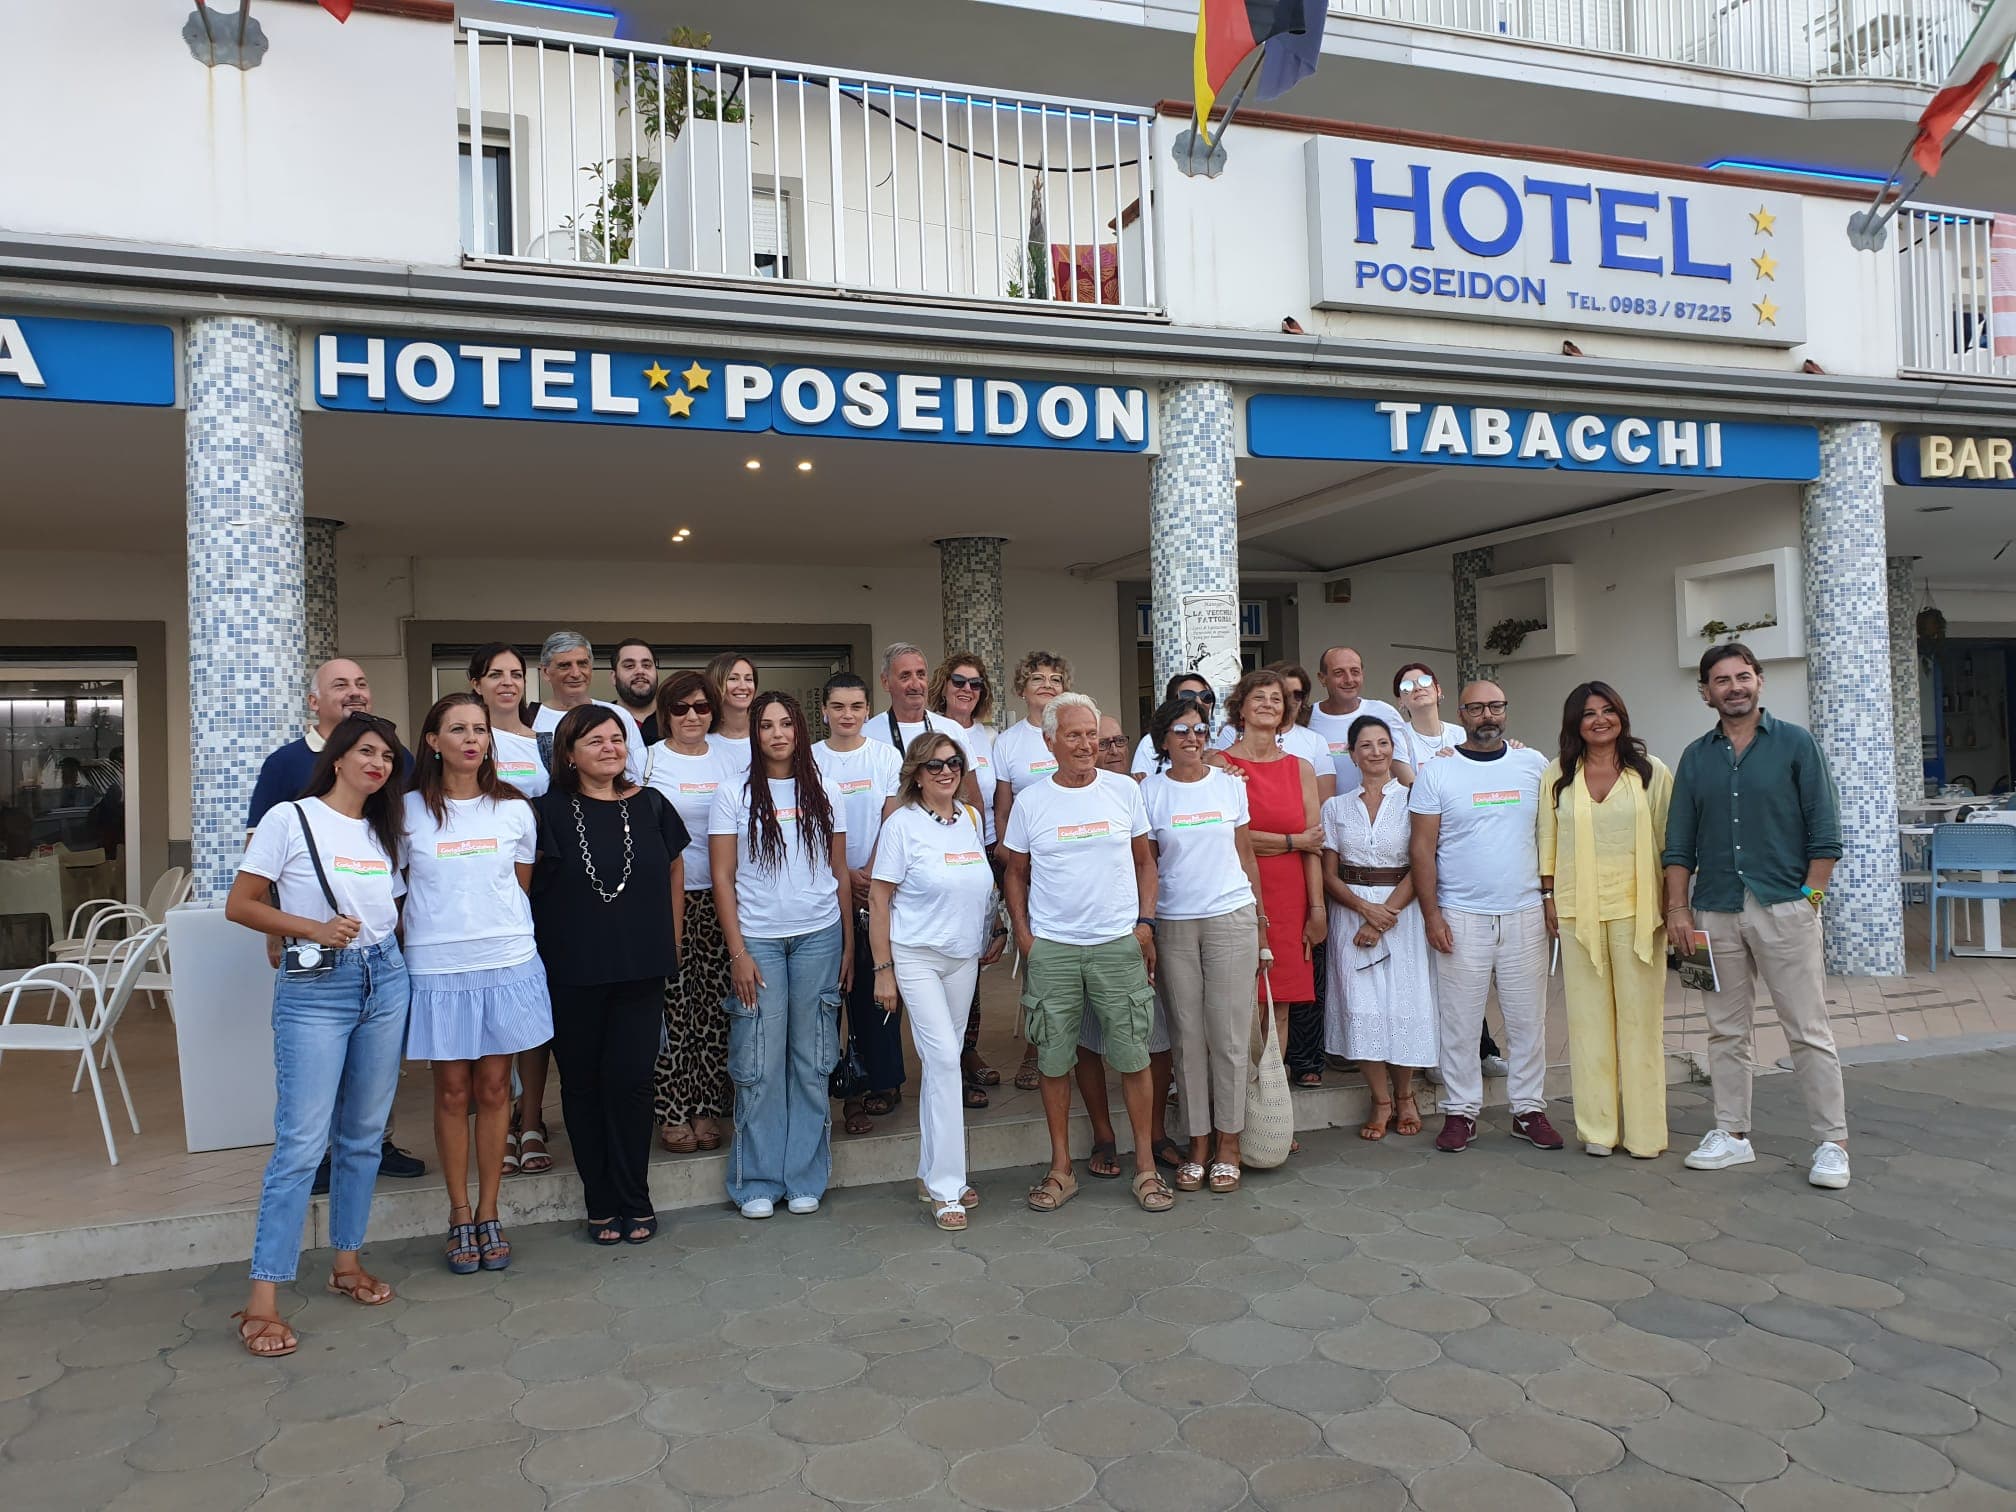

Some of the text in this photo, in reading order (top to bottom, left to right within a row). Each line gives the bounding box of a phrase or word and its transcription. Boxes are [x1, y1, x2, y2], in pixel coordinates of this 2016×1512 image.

[1350, 157, 1732, 284] HOTEL
[1354, 260, 1546, 306] POSEIDON
[1609, 295, 1657, 317] 0983
[1673, 302, 1733, 323] 87225
[318, 334, 1145, 443] HOTEL POSEIDON
[1375, 401, 1722, 469] TABACCHI
[1920, 435, 2015, 480] BAR
